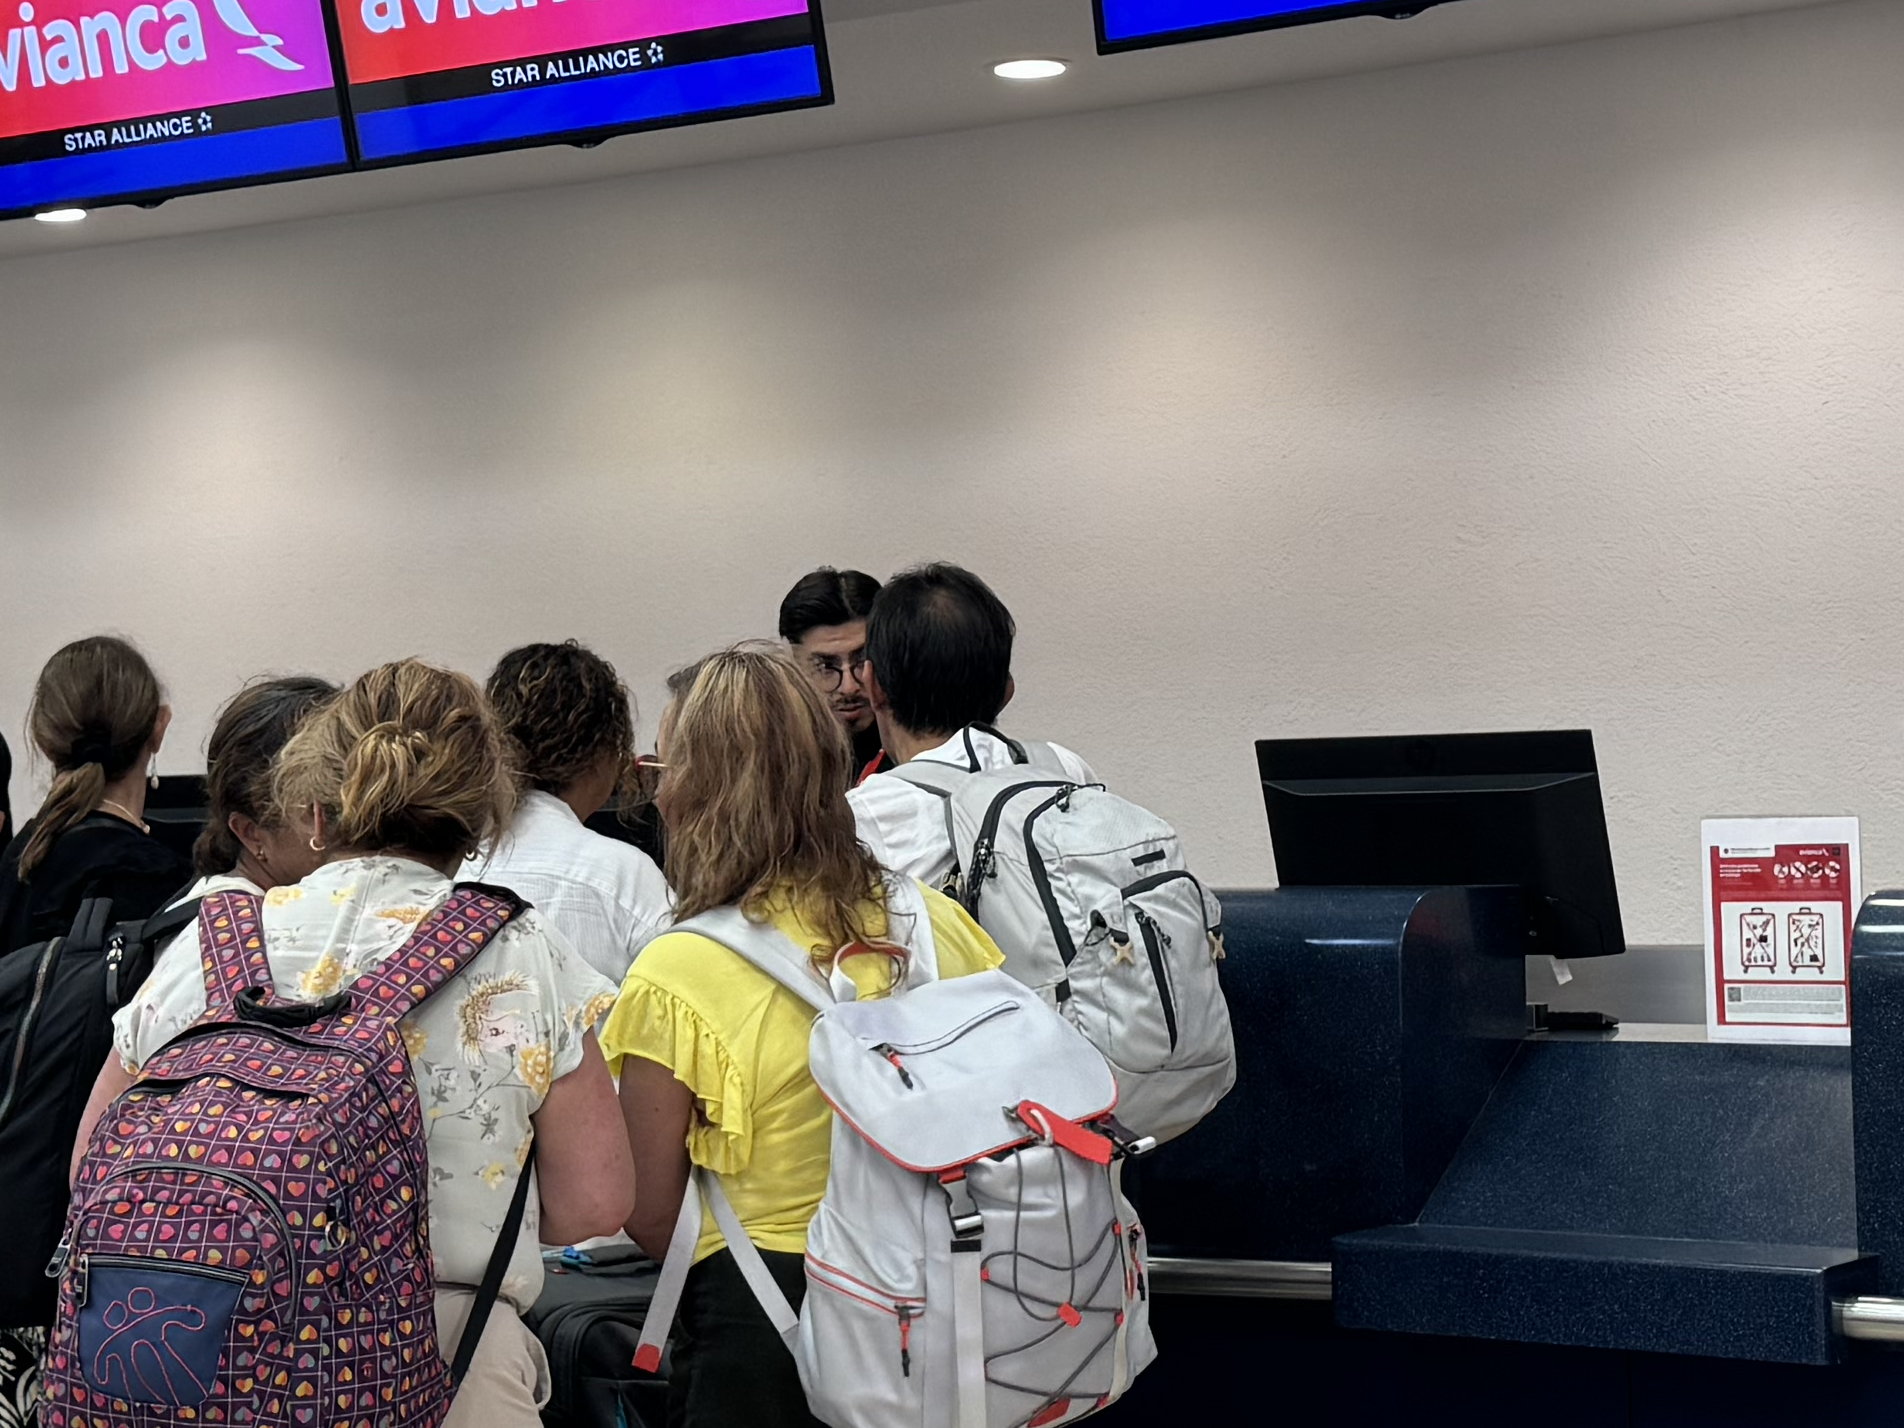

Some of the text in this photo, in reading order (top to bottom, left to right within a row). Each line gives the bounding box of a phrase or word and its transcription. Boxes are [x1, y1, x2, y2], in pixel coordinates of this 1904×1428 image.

[491, 48, 641, 88] STAR ALLIANCE
[64, 116, 193, 151] STAR ALLIANCE
